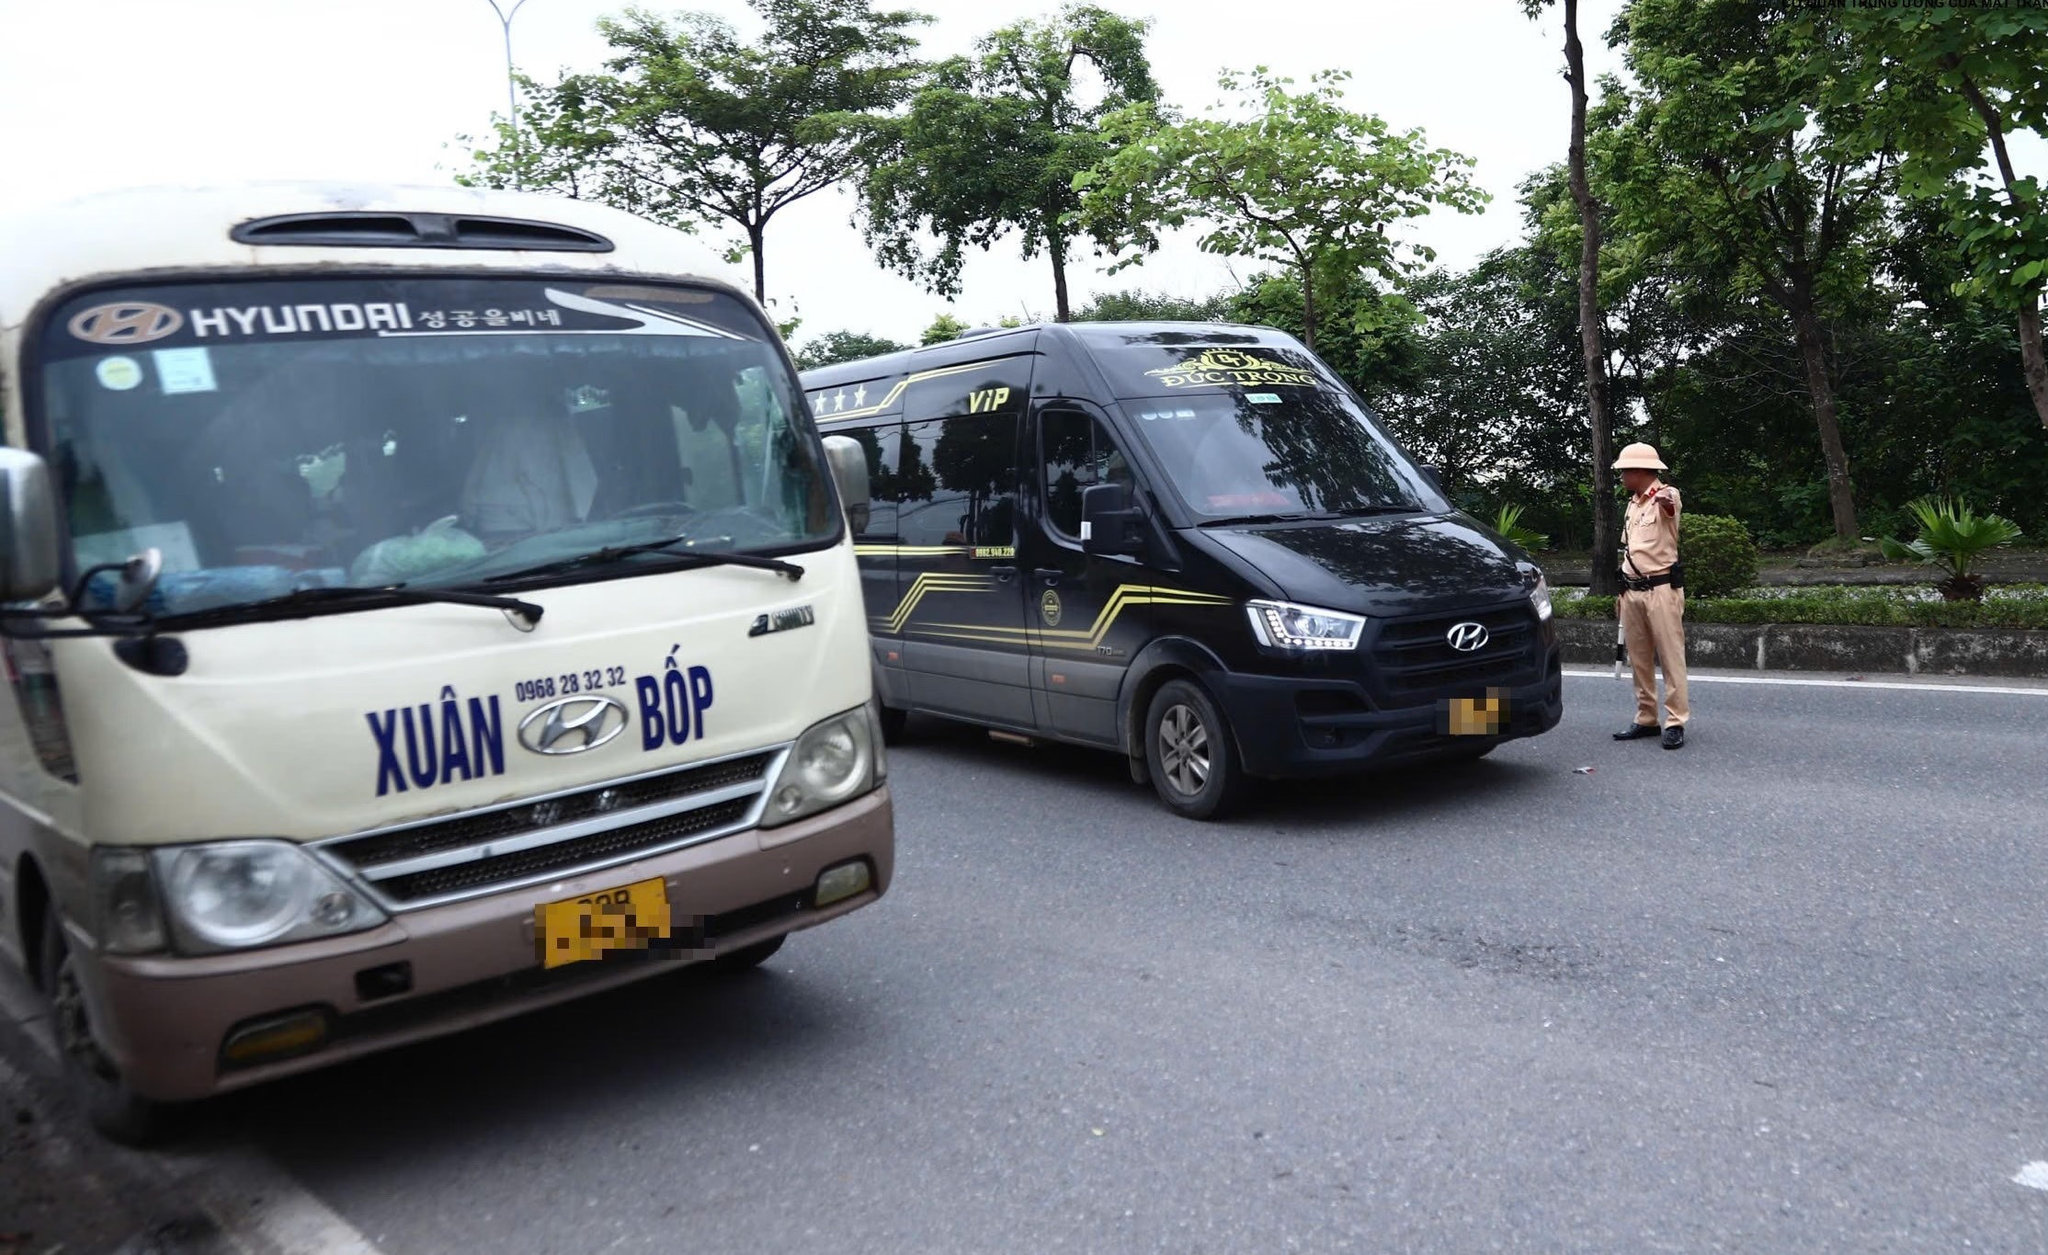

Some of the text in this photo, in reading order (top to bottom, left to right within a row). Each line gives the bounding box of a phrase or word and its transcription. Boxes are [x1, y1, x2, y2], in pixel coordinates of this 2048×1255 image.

[189, 302, 413, 337] HYUNDAI
[1227, 371, 1316, 385] TRỌNG
[515, 665, 626, 702] 0968 28 32 32
[365, 644, 714, 797] XUÂN BỐP
